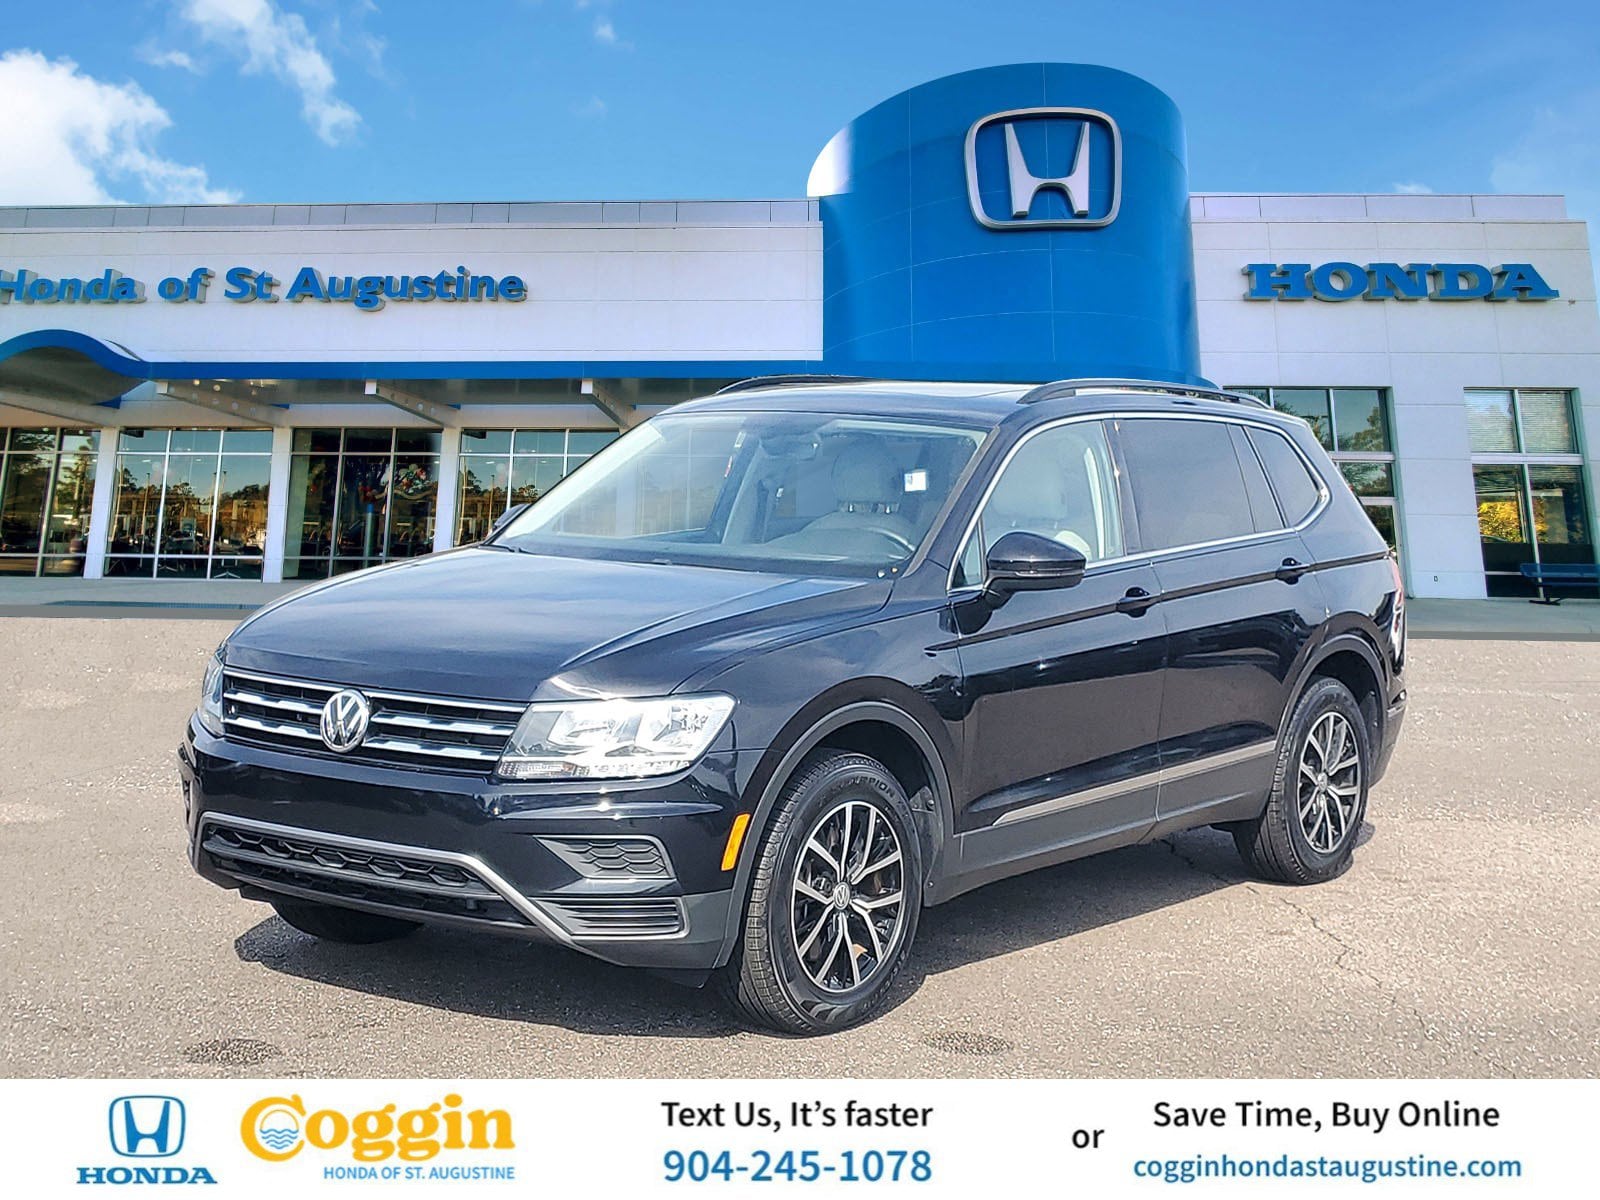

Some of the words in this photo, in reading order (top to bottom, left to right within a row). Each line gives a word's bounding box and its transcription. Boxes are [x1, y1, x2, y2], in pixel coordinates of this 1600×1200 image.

[0, 268, 145, 304] Honda
[157, 267, 215, 303] of
[224, 266, 280, 303] St
[285, 265, 528, 312] Augustine
[1242, 261, 1560, 302] HONDA
